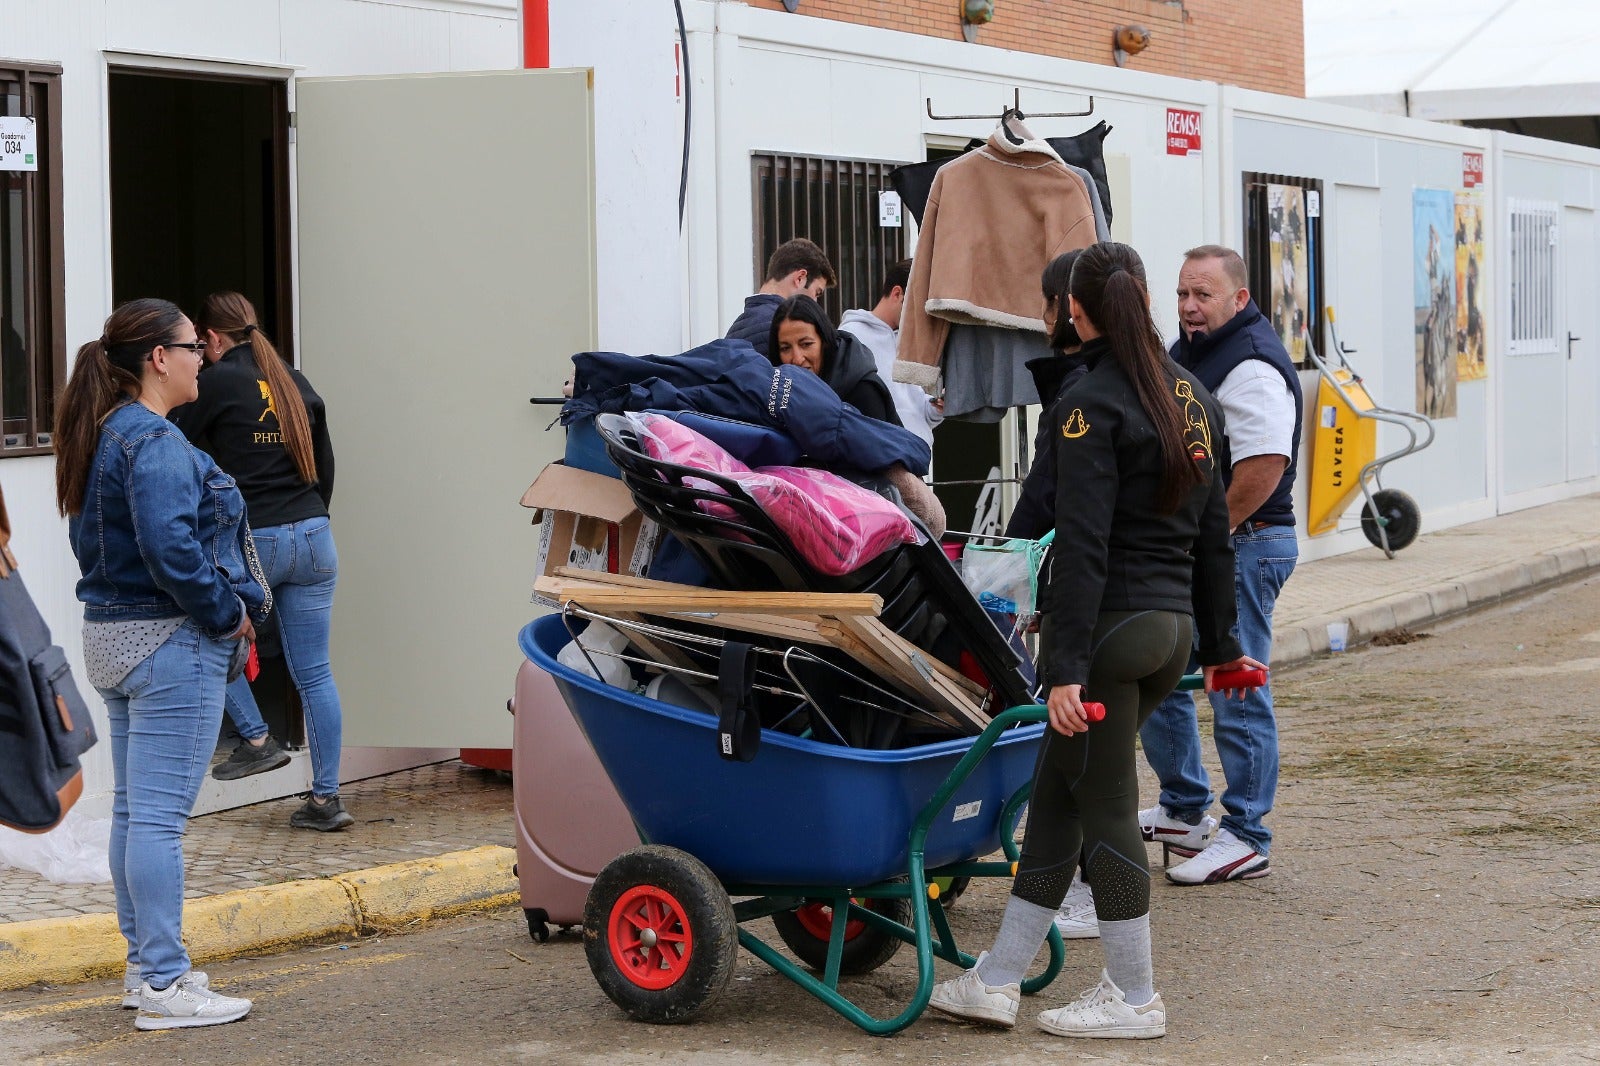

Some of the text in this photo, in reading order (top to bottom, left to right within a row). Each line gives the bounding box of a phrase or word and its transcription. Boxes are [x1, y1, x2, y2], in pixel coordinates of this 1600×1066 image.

[1168, 111, 1201, 136] REMSA
[5, 141, 21, 154] 034
[253, 432, 287, 443] PHT
